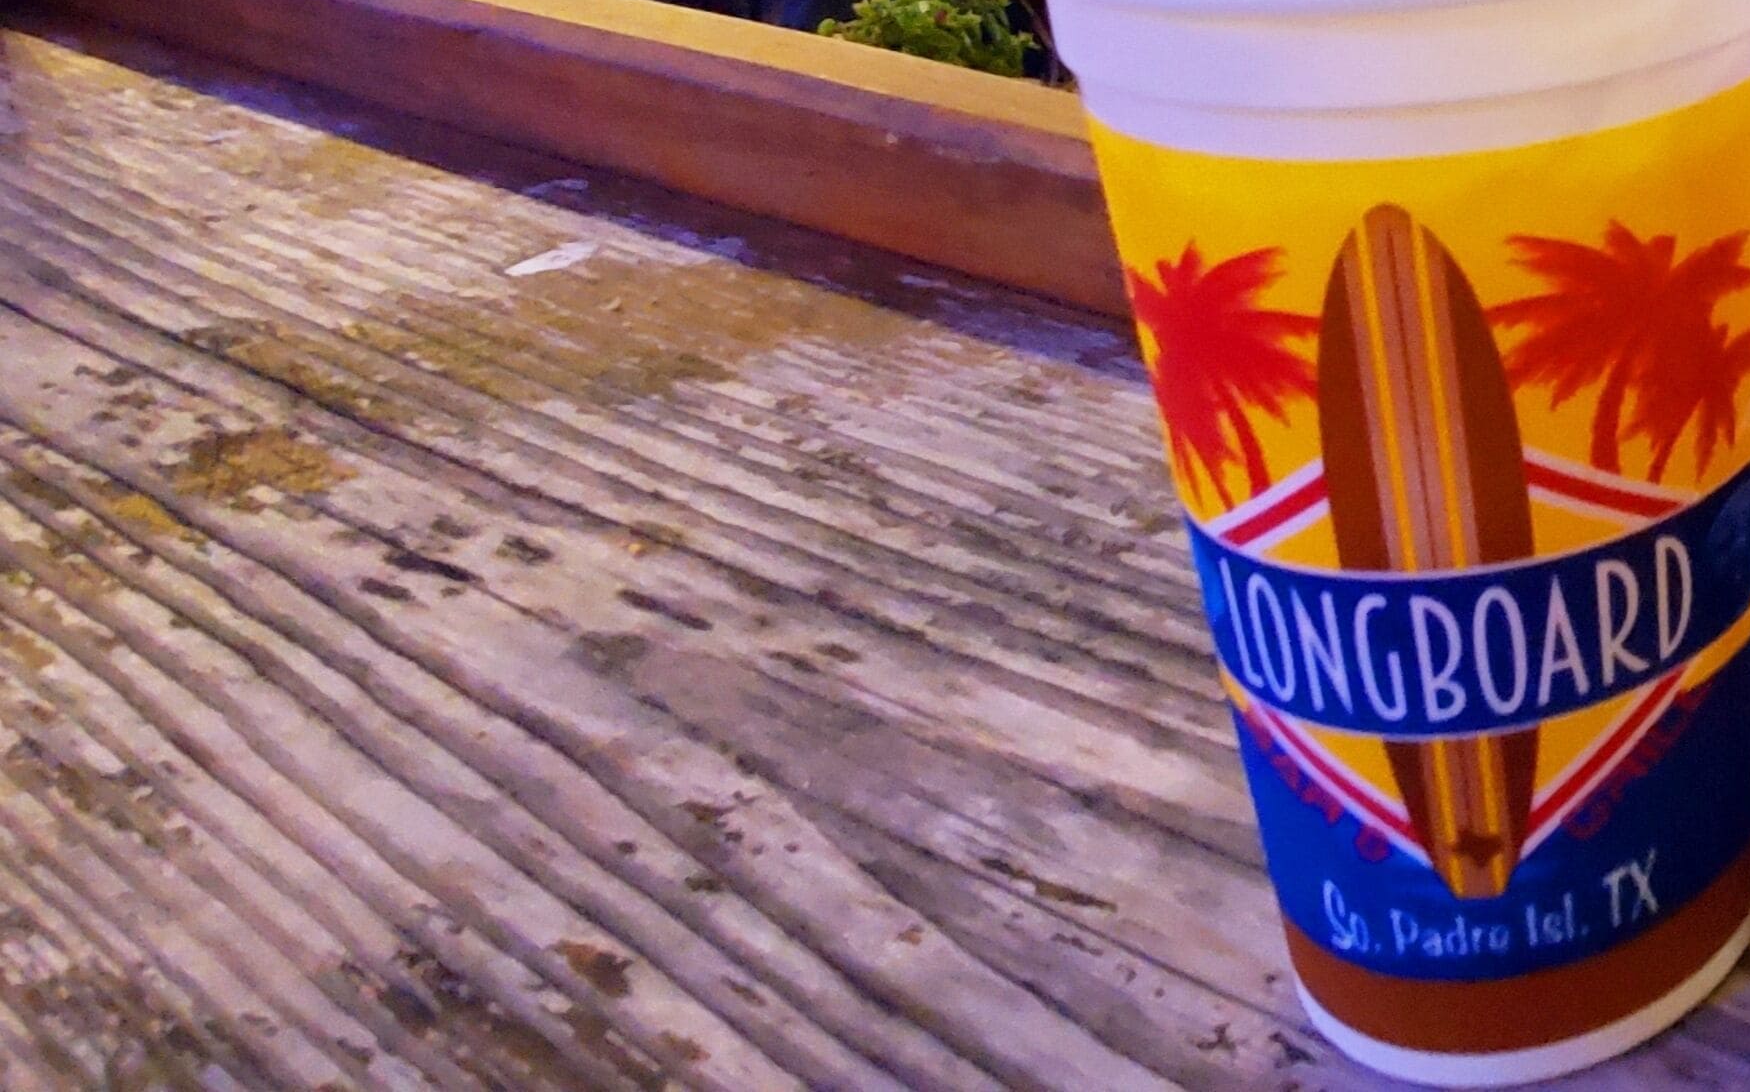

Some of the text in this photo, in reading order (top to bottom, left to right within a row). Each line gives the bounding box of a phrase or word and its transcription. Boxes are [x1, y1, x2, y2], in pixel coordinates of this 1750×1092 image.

[1218, 534, 1694, 724] LONGBOARD
[1322, 879, 1381, 953] So.
[1602, 848, 1660, 928] TX
